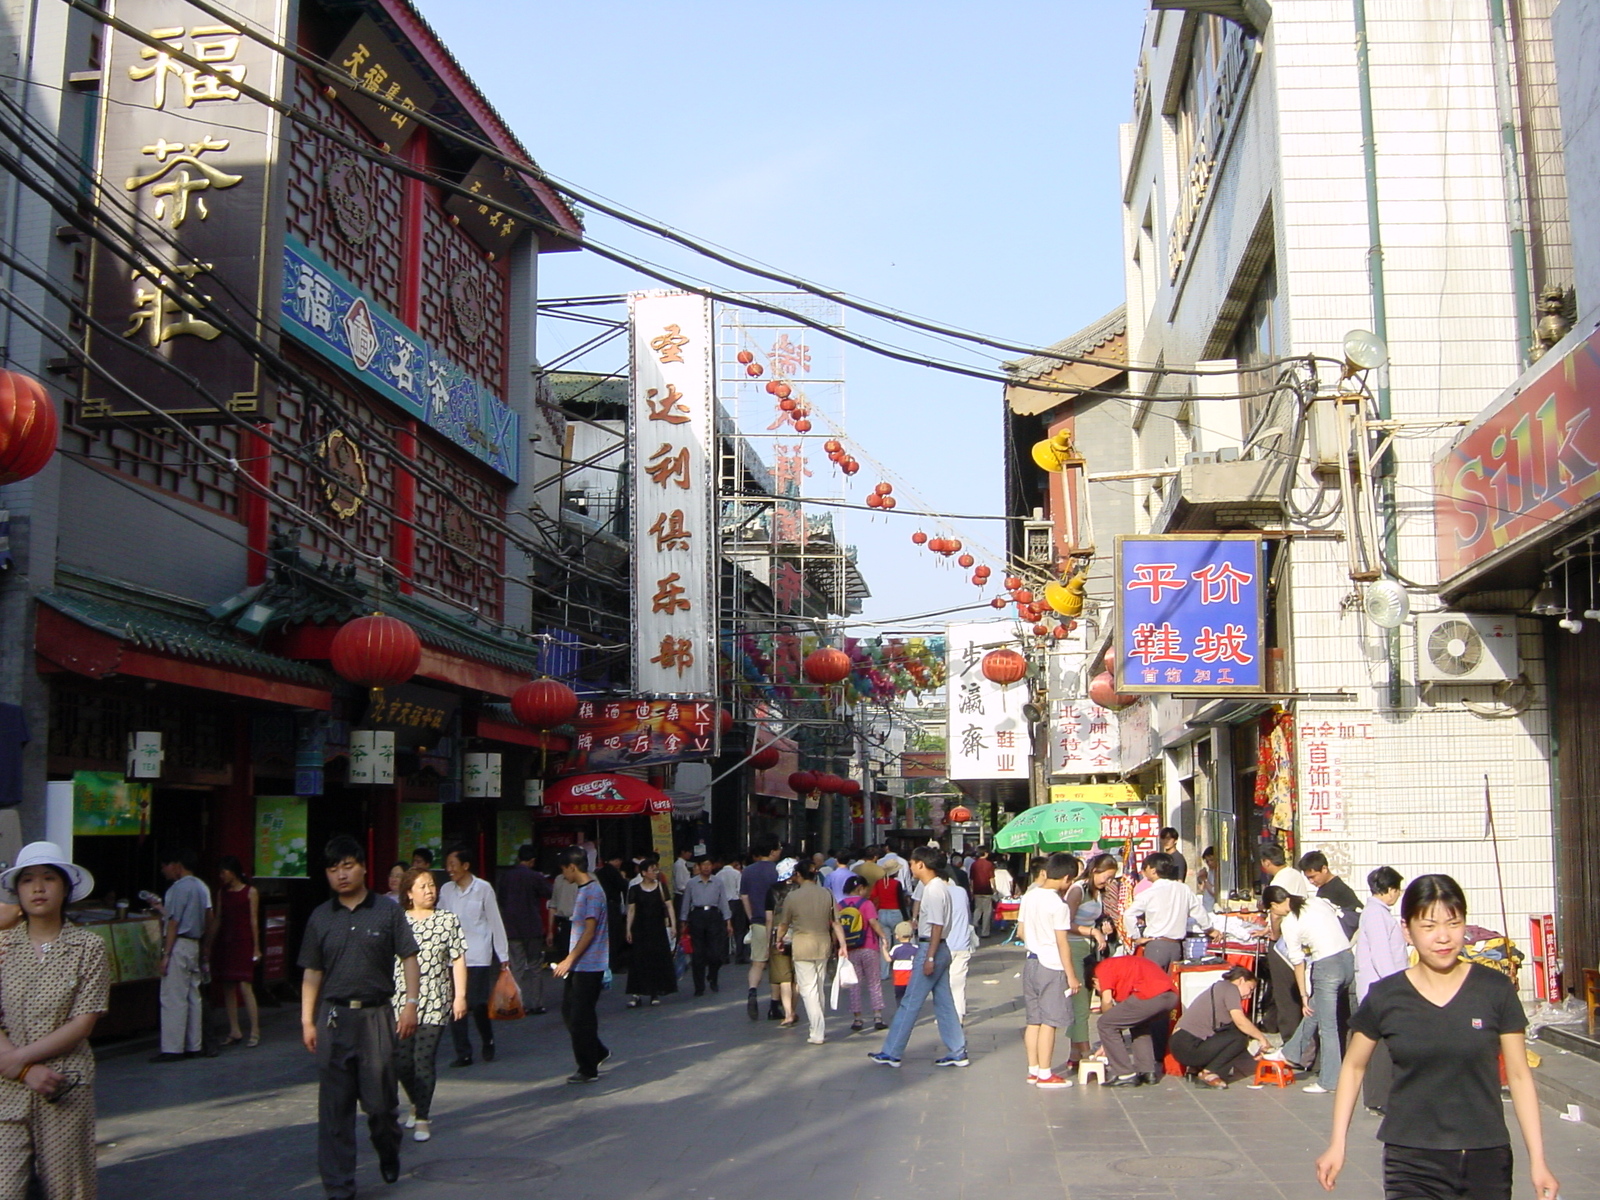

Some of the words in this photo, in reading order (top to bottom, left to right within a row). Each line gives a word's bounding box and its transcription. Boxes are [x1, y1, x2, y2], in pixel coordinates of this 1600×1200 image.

[1452, 392, 1598, 550] Silk
[644, 323, 694, 679] 圣达利俱乐部
[1127, 561, 1252, 605] 平价
[1128, 622, 1253, 665] 鞋城
[1141, 667, 1234, 684] 首饰加工
[604, 703, 622, 749] 酒吧
[665, 703, 681, 753] 桑拿
[694, 703, 710, 751] KTV
[1059, 704, 1083, 767] 北京特产
[1087, 705, 1112, 767] 果脯大全
[1300, 721, 1374, 740] 白金加工
[997, 731, 1015, 772] 鞋业
[1308, 741, 1331, 832] 首饰加工
